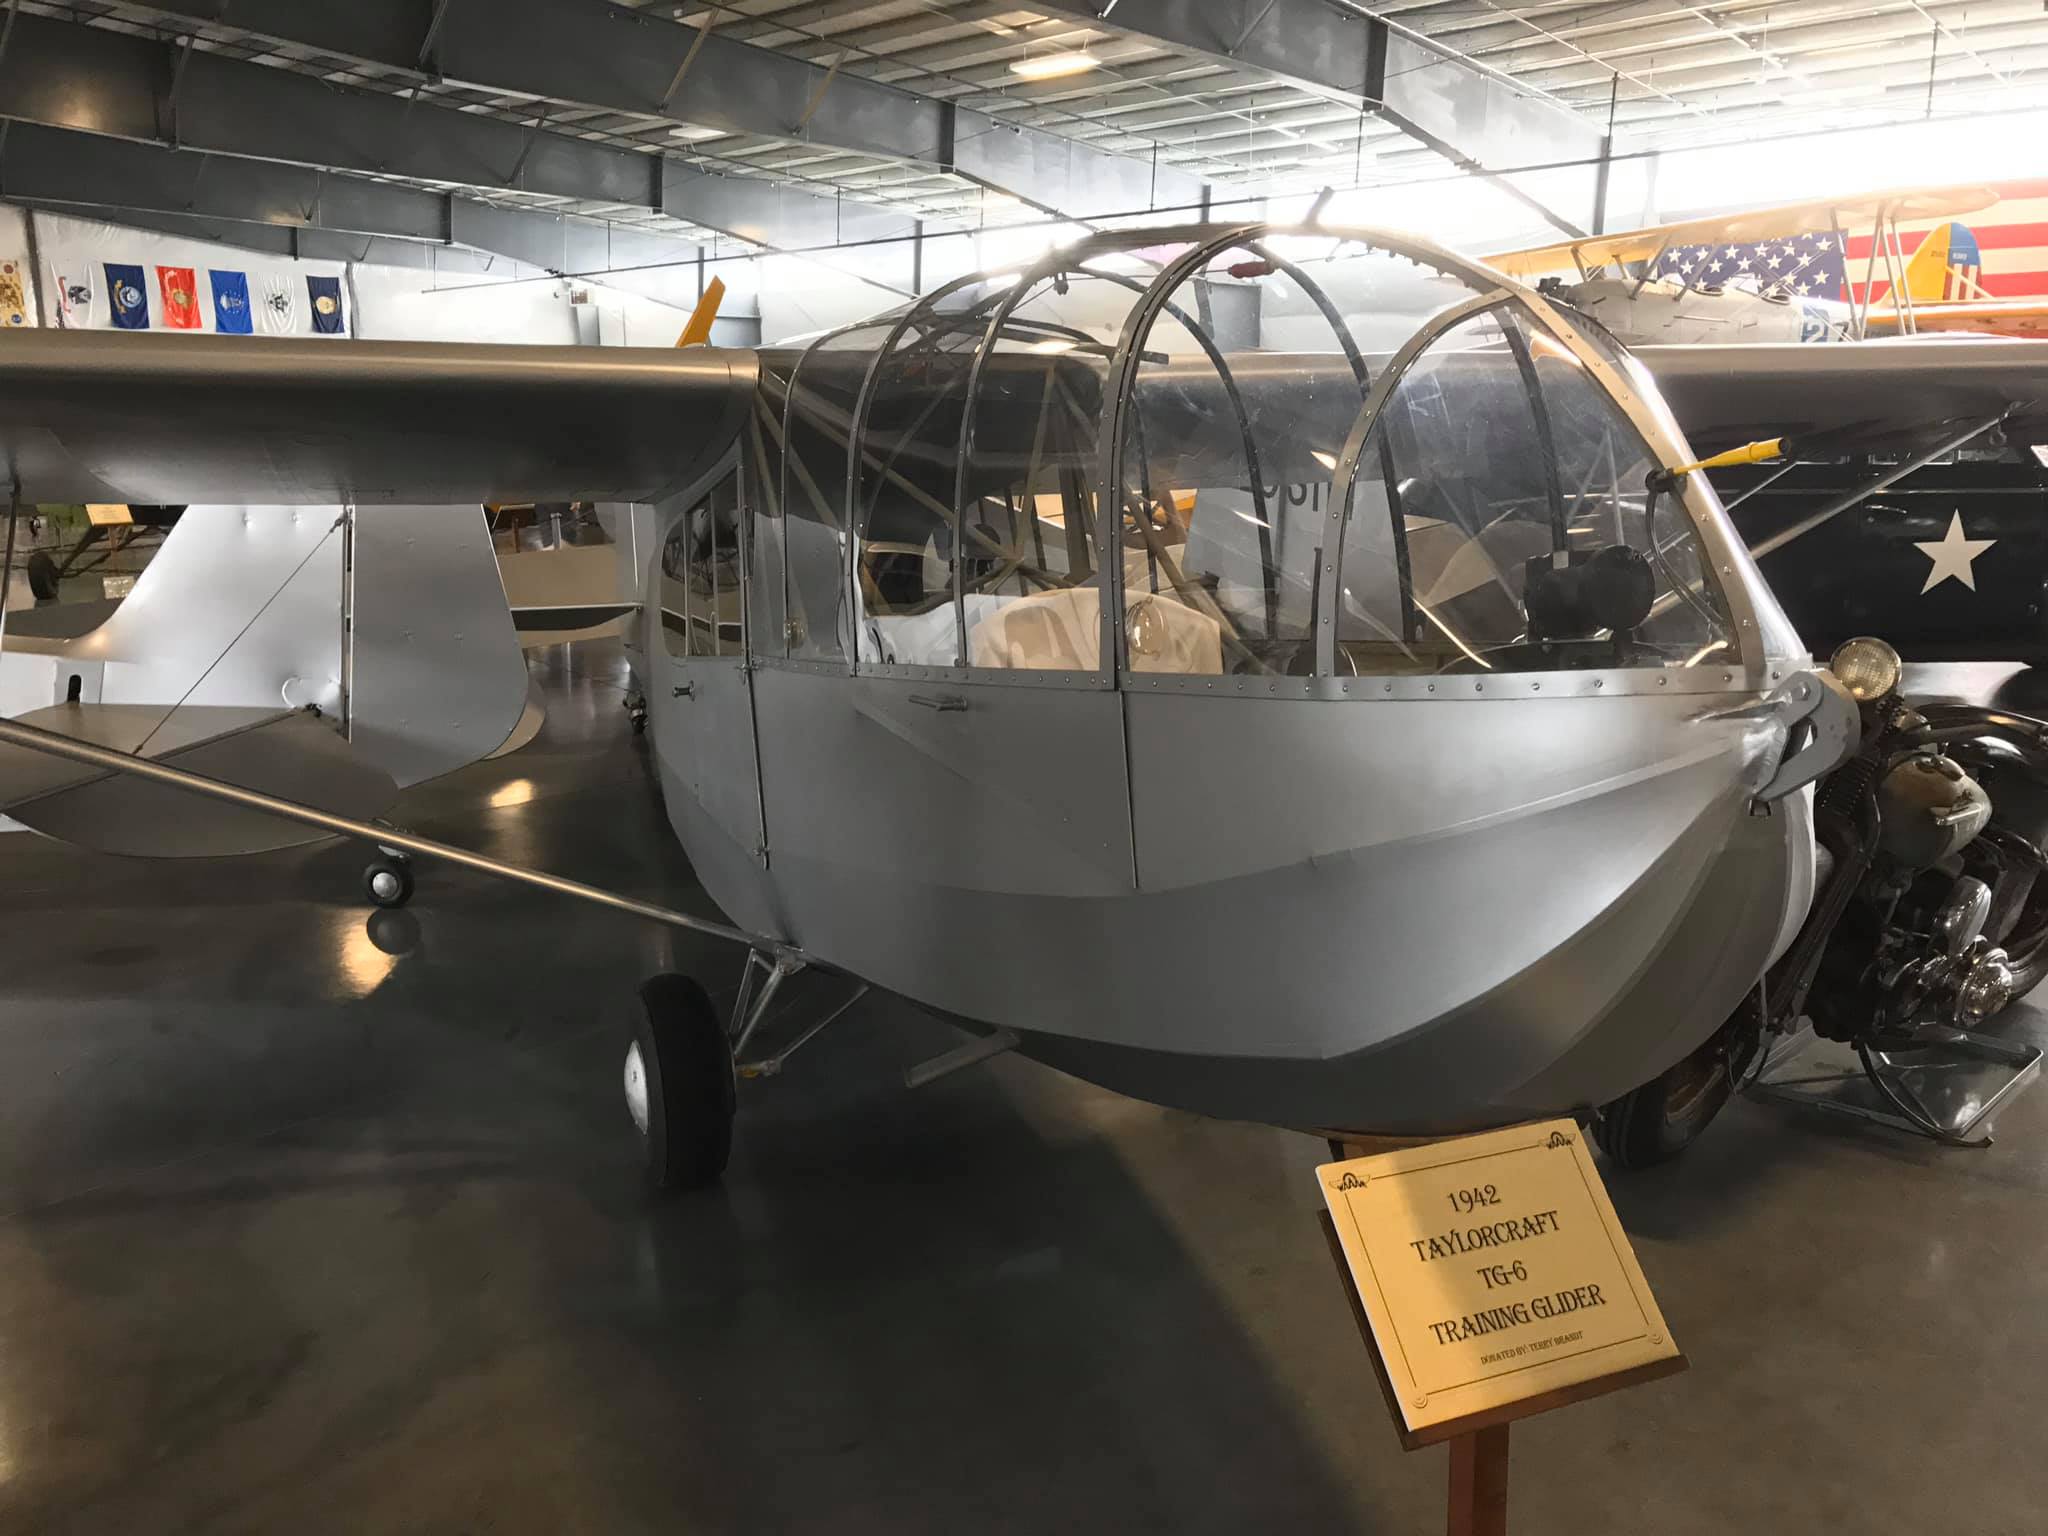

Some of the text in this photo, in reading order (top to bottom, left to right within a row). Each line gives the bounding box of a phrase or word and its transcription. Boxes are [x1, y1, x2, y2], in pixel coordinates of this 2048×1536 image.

[1447, 1184, 1502, 1213] 1942
[1410, 1210, 1560, 1262] TAYLORCRAFT
[1477, 1260, 1527, 1289] TG-6
[1428, 1283, 1607, 1345] TRAINING GLIDER
[1480, 1349, 1516, 1365] DONATED
[1528, 1337, 1553, 1352] TERRY
[1553, 1330, 1584, 1346] BRANDT
